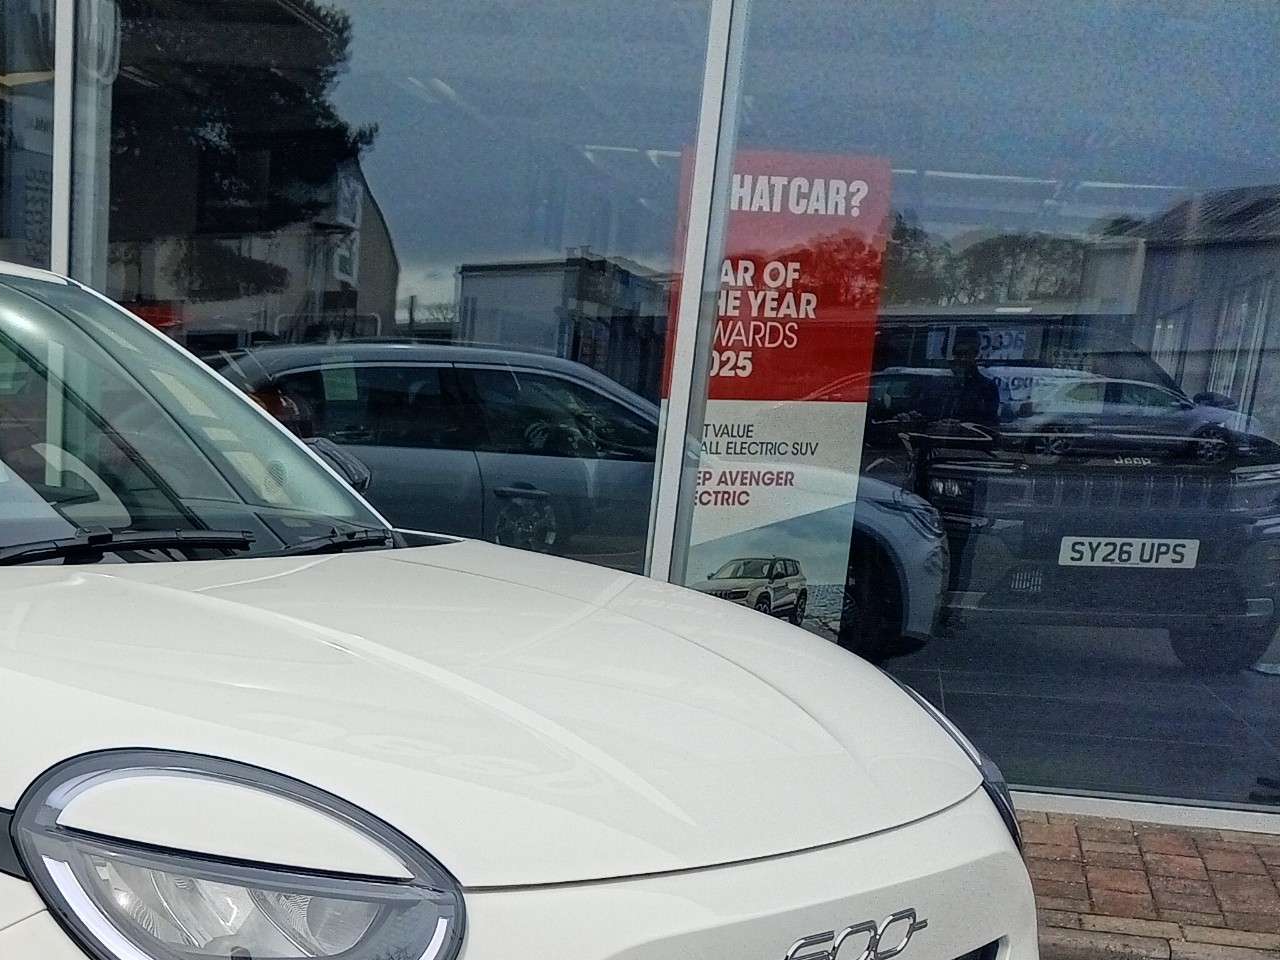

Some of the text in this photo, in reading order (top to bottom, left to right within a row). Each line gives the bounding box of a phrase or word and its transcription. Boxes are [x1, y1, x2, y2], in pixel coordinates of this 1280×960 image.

[721, 259, 801, 288] AR OF
[748, 291, 818, 319] YEAR
[712, 320, 799, 349] WARDS
[713, 424, 754, 438] VALUE
[700, 441, 819, 456] ALL ELECTRIC SUV
[716, 471, 795, 486] AVENGER
[1070, 541, 1187, 564] SY26 UPS
